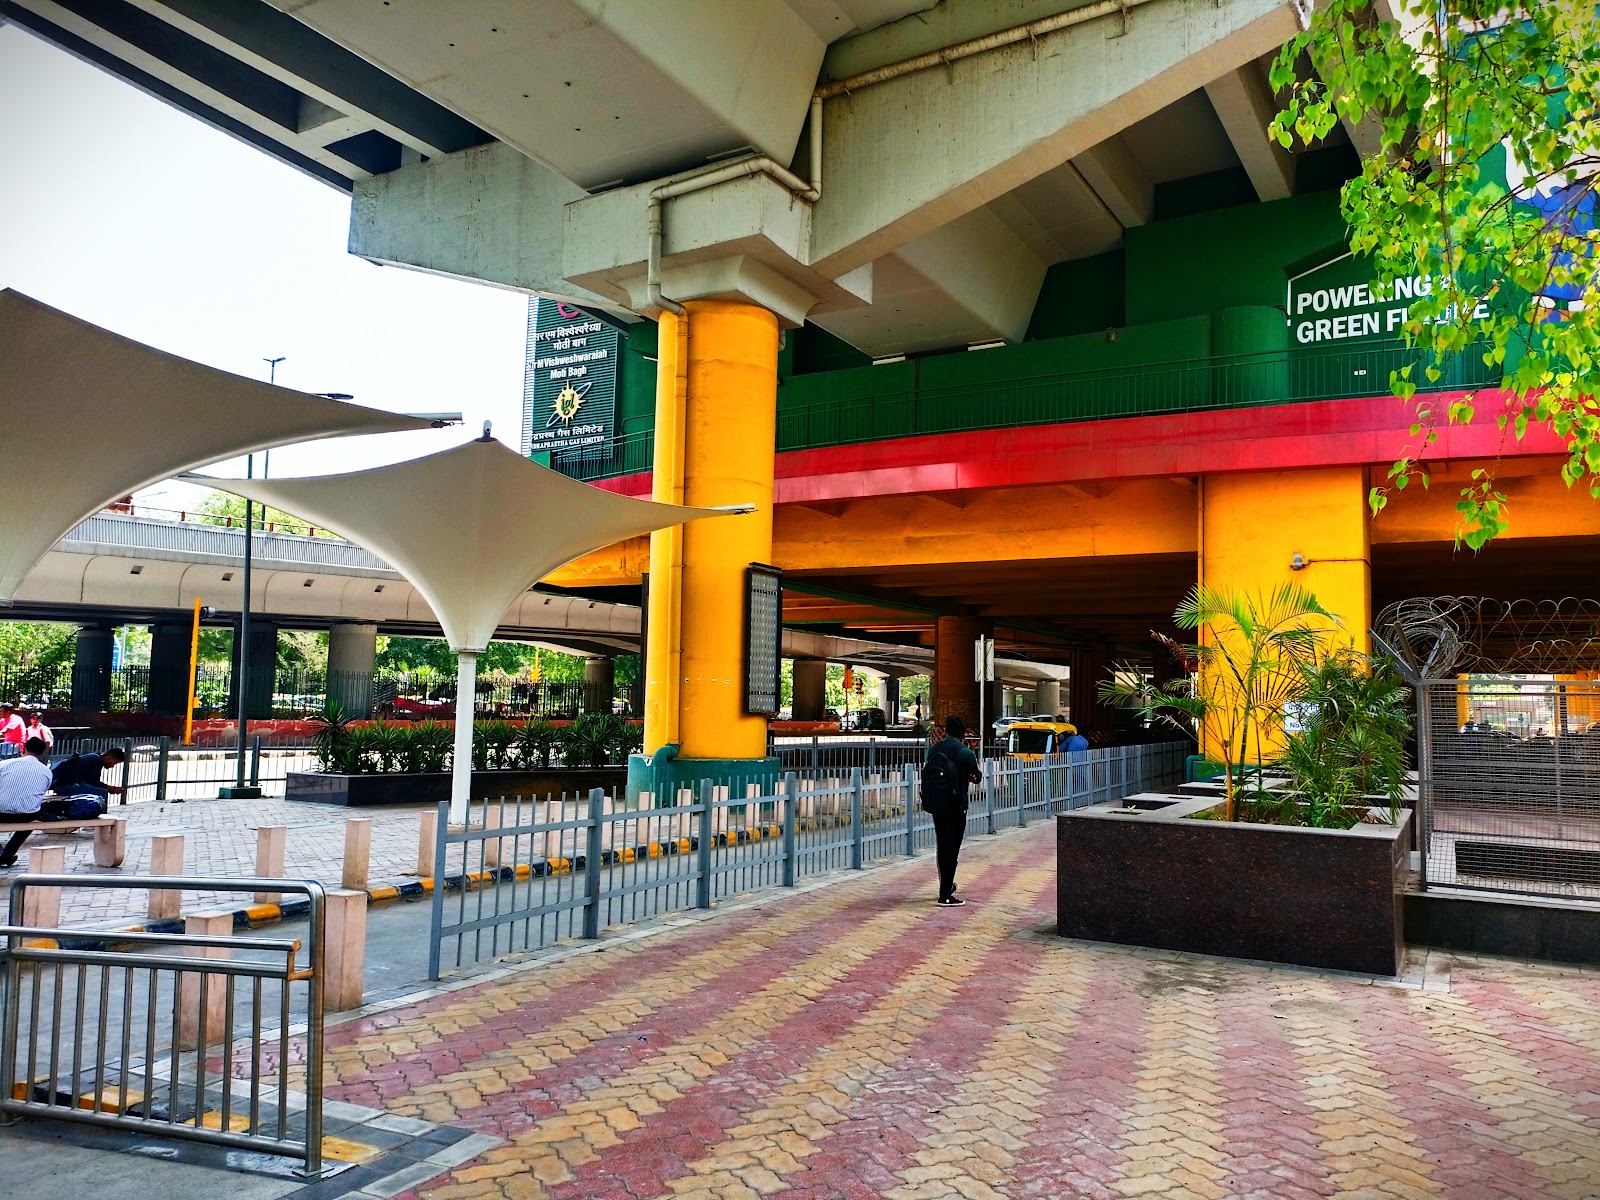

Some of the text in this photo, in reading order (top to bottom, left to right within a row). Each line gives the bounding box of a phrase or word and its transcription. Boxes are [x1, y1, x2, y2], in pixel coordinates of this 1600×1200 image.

[1296, 294, 1490, 343] GREEN FURE
[537, 359, 544, 368] M
[544, 349, 608, 367] Vishweshwaraiah
[550, 365, 587, 379] Moti Bagh
[569, 438, 580, 446] GAS
